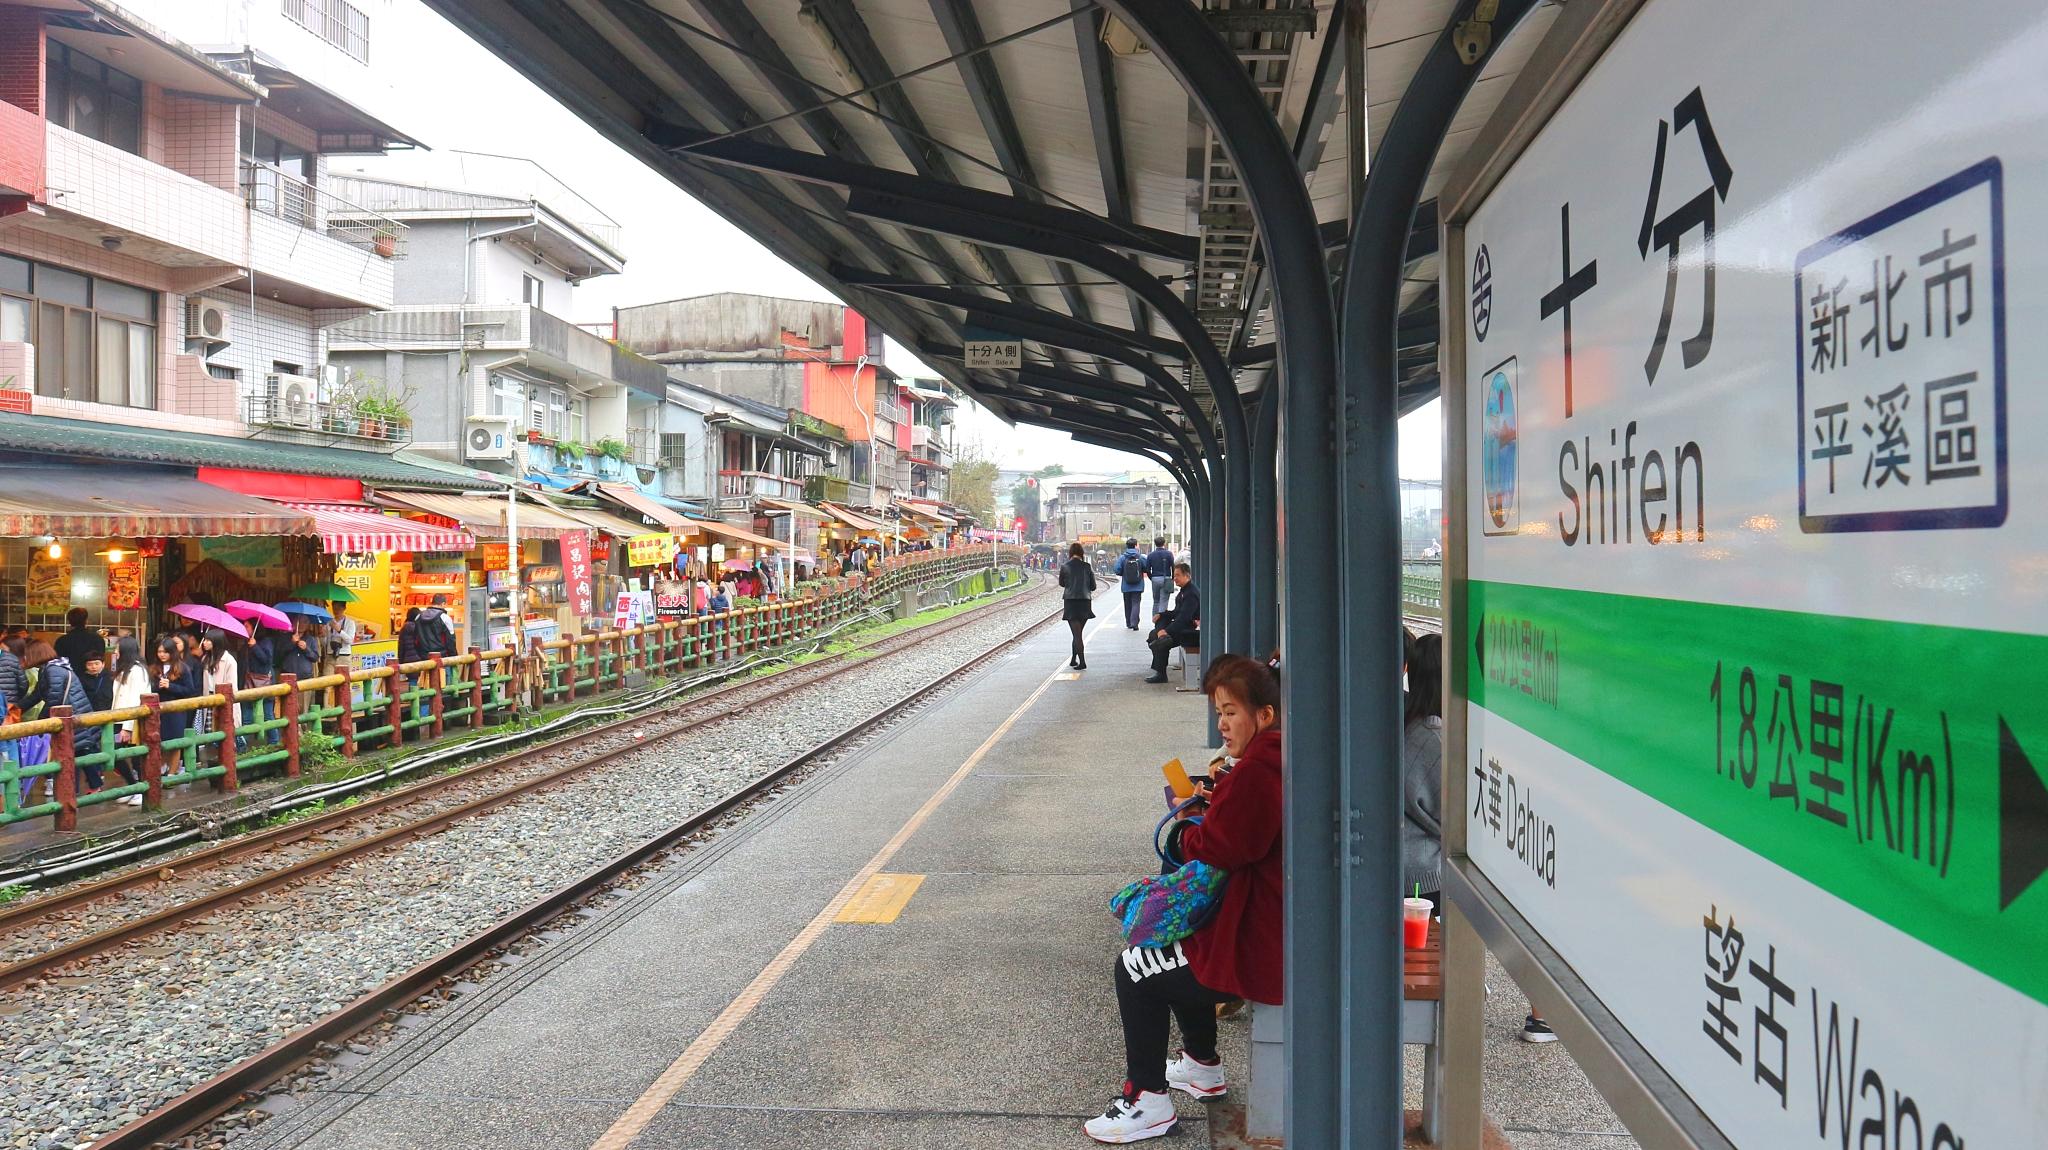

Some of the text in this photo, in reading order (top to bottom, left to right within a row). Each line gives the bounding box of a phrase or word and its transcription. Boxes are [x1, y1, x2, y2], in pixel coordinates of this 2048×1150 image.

[1540, 85, 1734, 418] 十分
[1810, 228, 1978, 374] 新北市
[1558, 421, 1705, 547] Shifen
[1811, 371, 1982, 494] 平溪區
[657, 593, 689, 607] 煙火
[1474, 748, 1503, 838] 大華
[1506, 774, 1556, 890] Dahua
[1703, 903, 1796, 1111] 望古
[1811, 986, 1965, 1150] Wan
